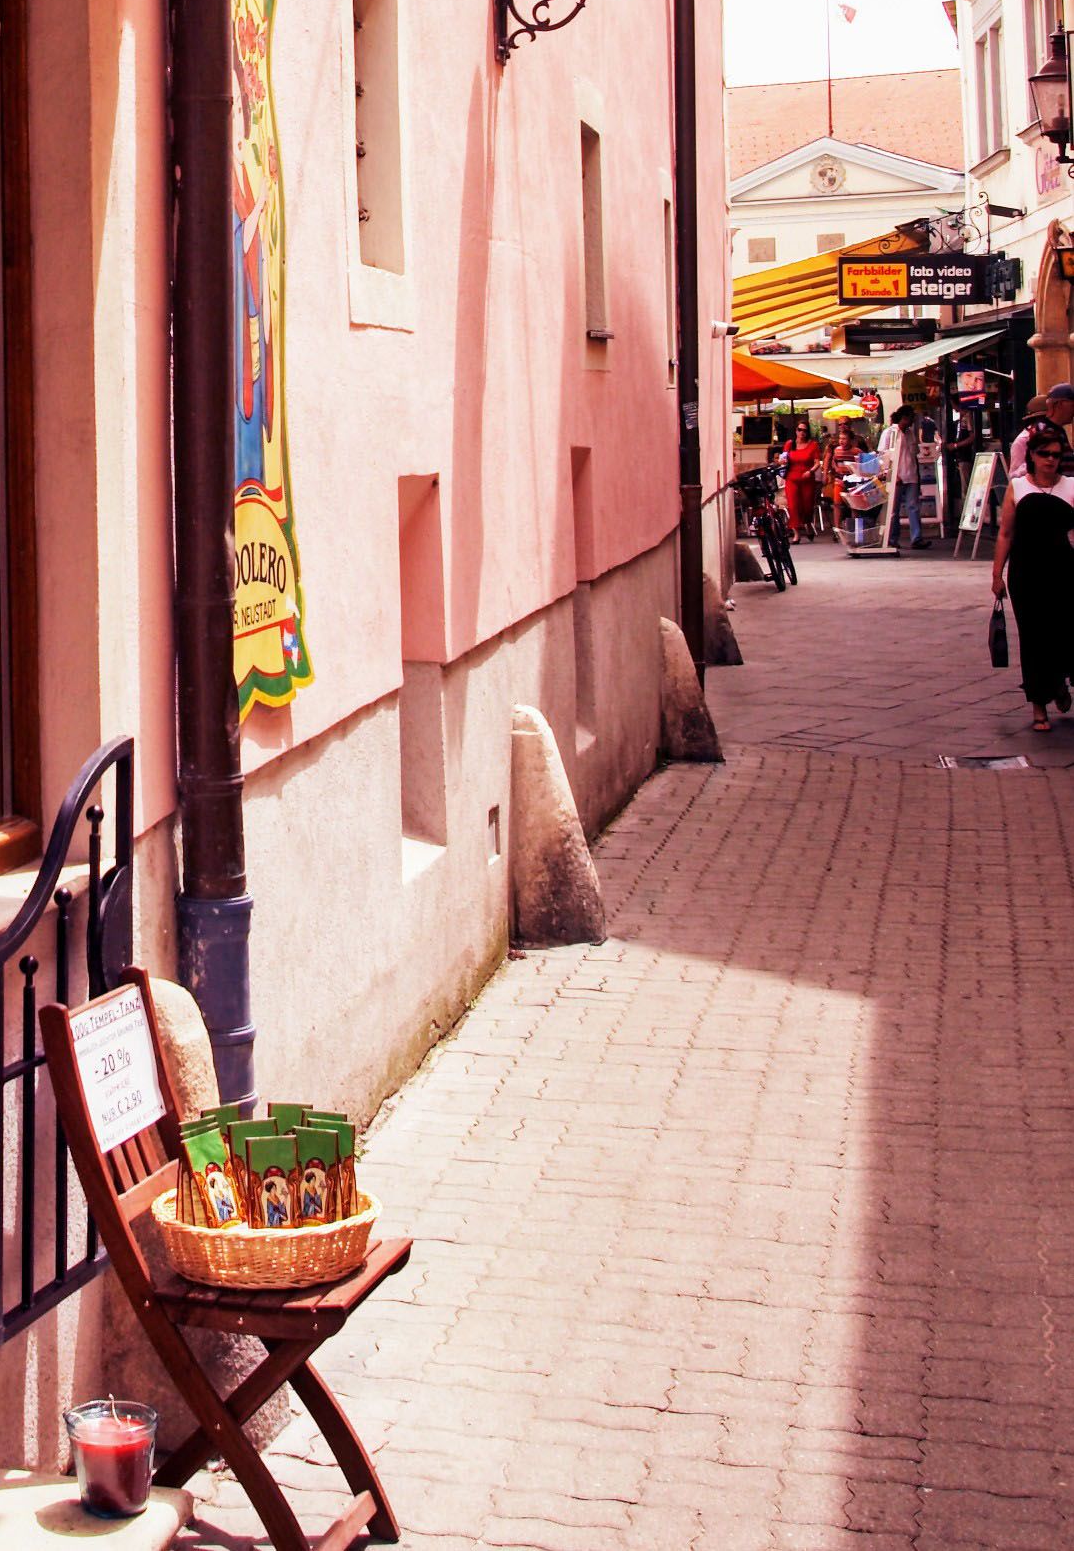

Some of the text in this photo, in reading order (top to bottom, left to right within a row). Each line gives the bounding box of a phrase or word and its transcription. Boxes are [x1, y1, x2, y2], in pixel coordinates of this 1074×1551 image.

[847, 266, 903, 277] Farbbilder
[910, 265, 972, 277] foto video
[850, 282, 858, 297] 1
[910, 279, 973, 299] steiger
[242, 598, 277, 627] NEUSTADT
